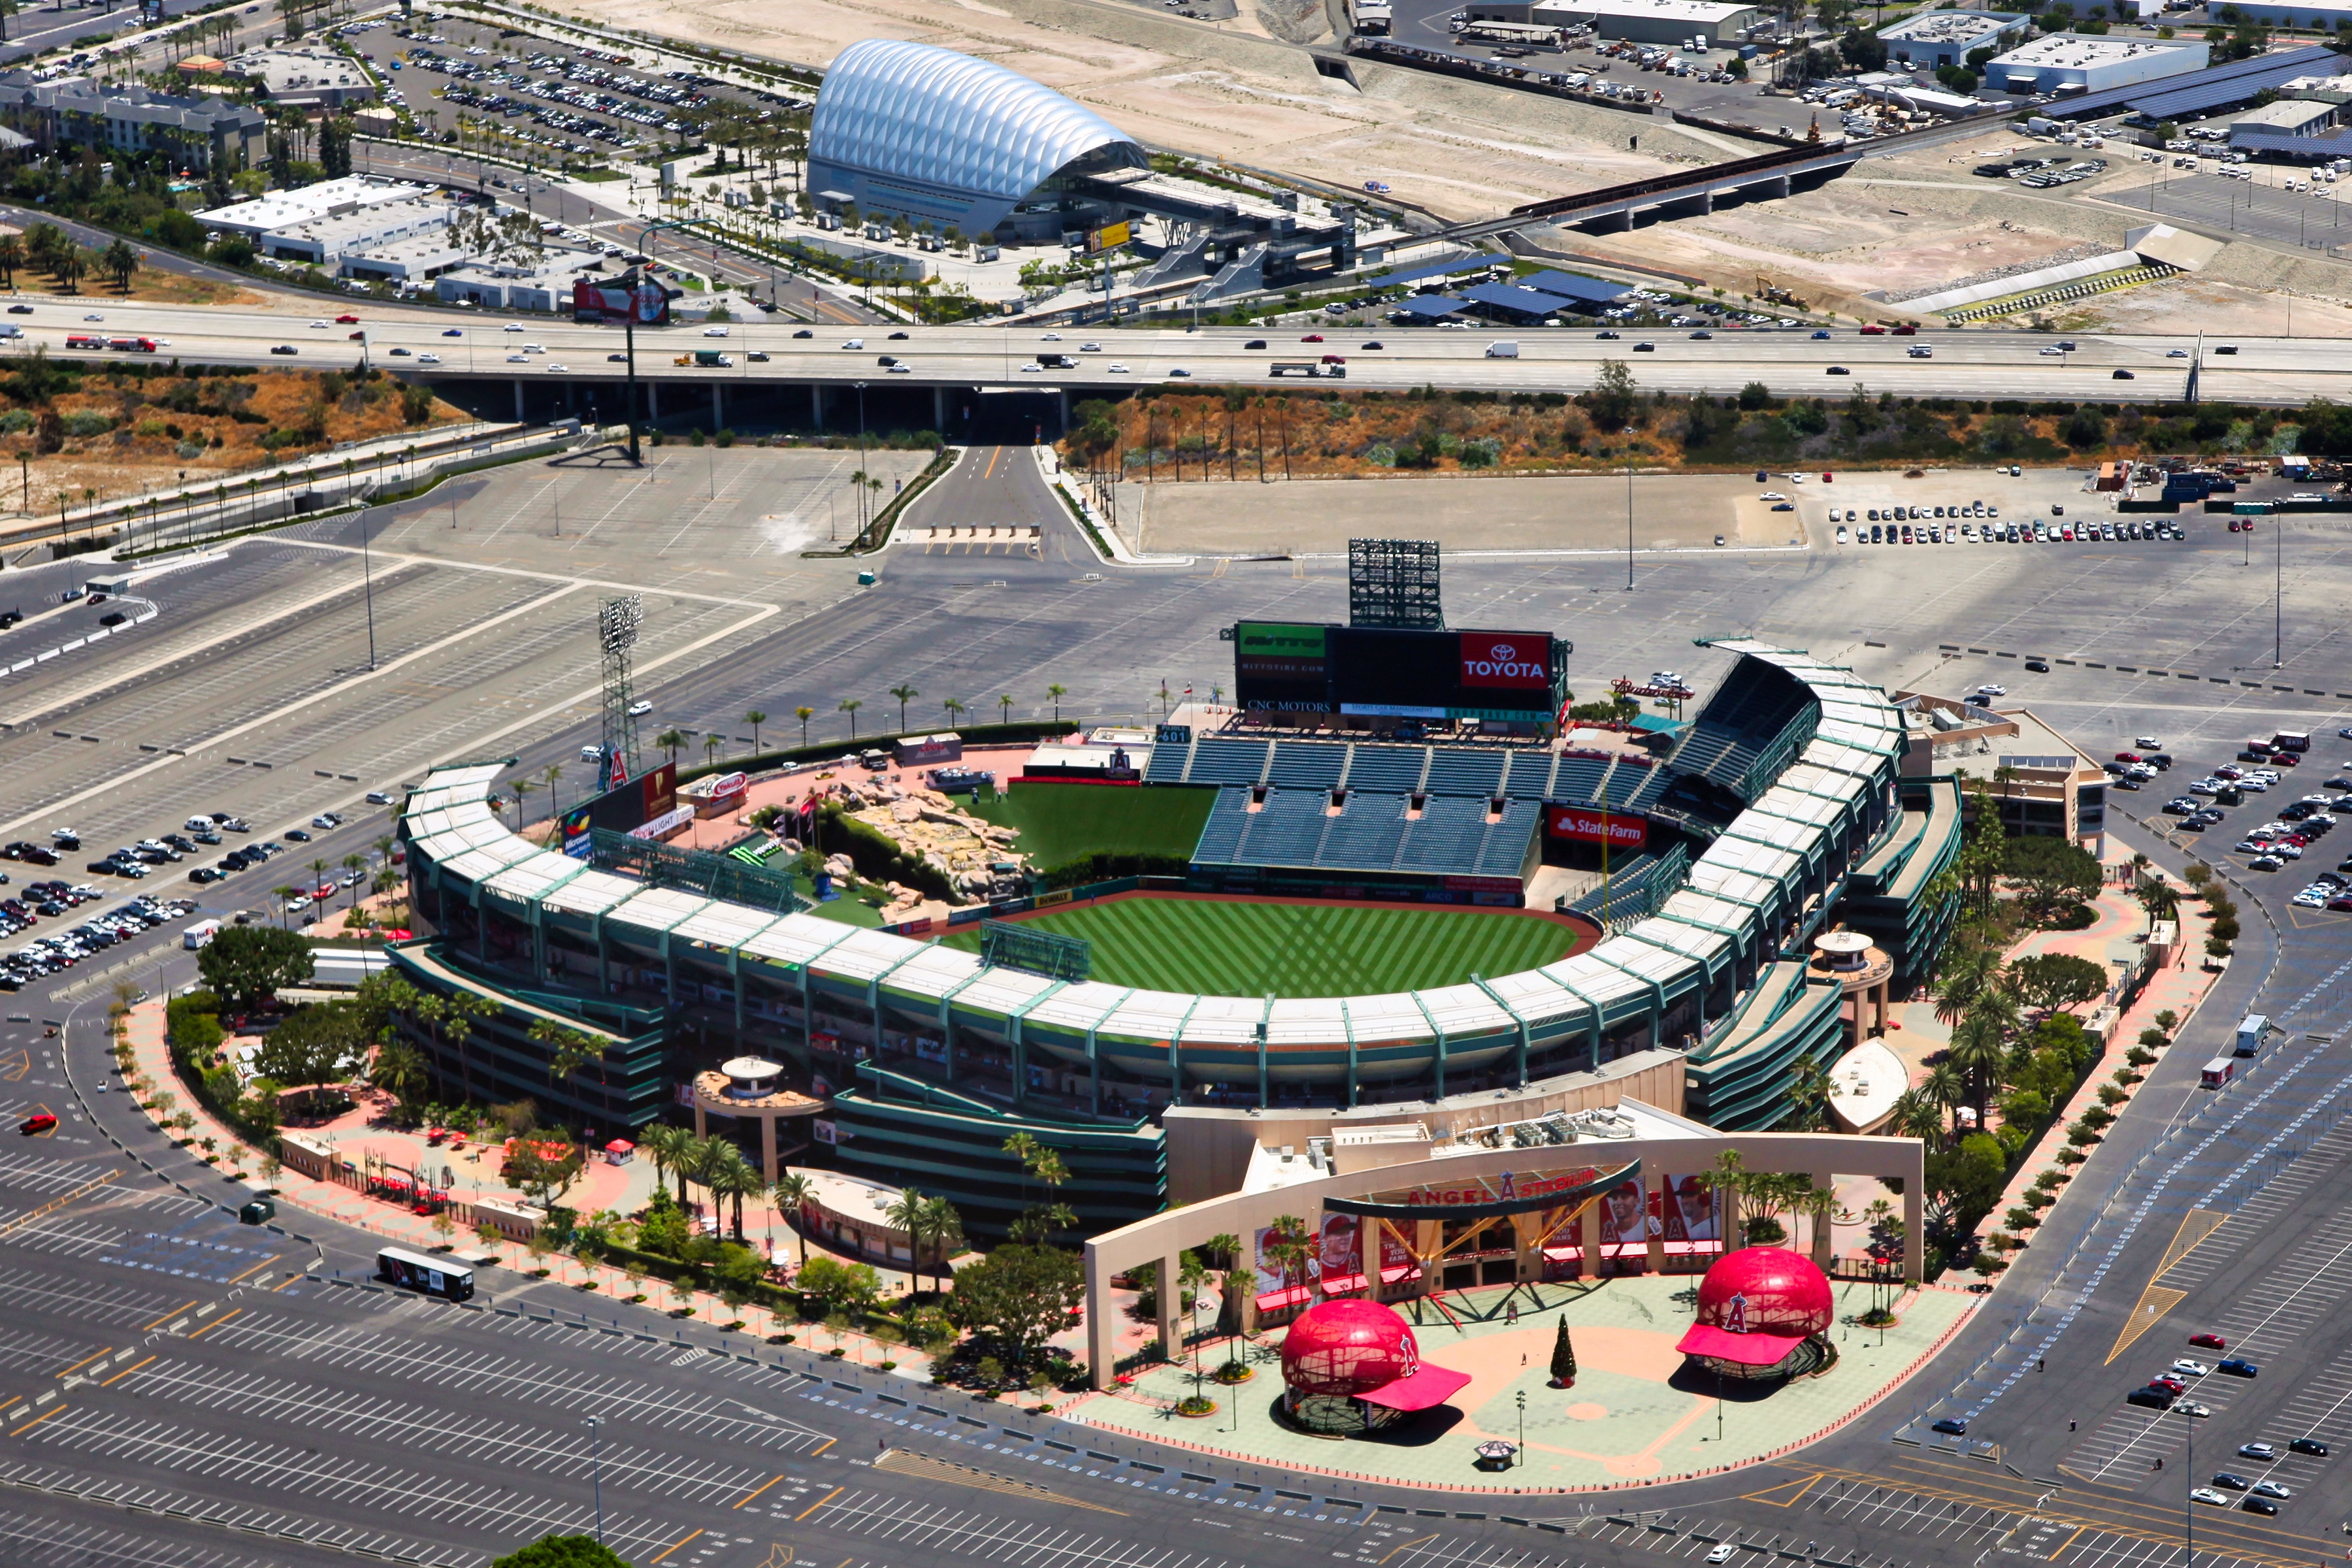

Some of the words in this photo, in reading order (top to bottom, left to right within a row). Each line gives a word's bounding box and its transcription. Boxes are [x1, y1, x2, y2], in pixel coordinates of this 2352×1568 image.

[1464, 661, 1544, 678] TOYOTA
[1247, 700, 1275, 710] CNC
[1278, 701, 1331, 713] MOTORS
[1162, 731, 1184, 743] 601
[719, 777, 742, 792] Yakult
[654, 815, 674, 833] LIGHT
[1576, 819, 1609, 836] State
[1609, 825, 1641, 840] Farm
[1425, 892, 1452, 902] ARCO
[197, 928, 214, 940] FedEx
[1407, 1188, 1497, 1205] ANGEL
[1519, 1167, 1596, 1198] STADIUM
[1388, 1254, 1407, 1262] FANS
